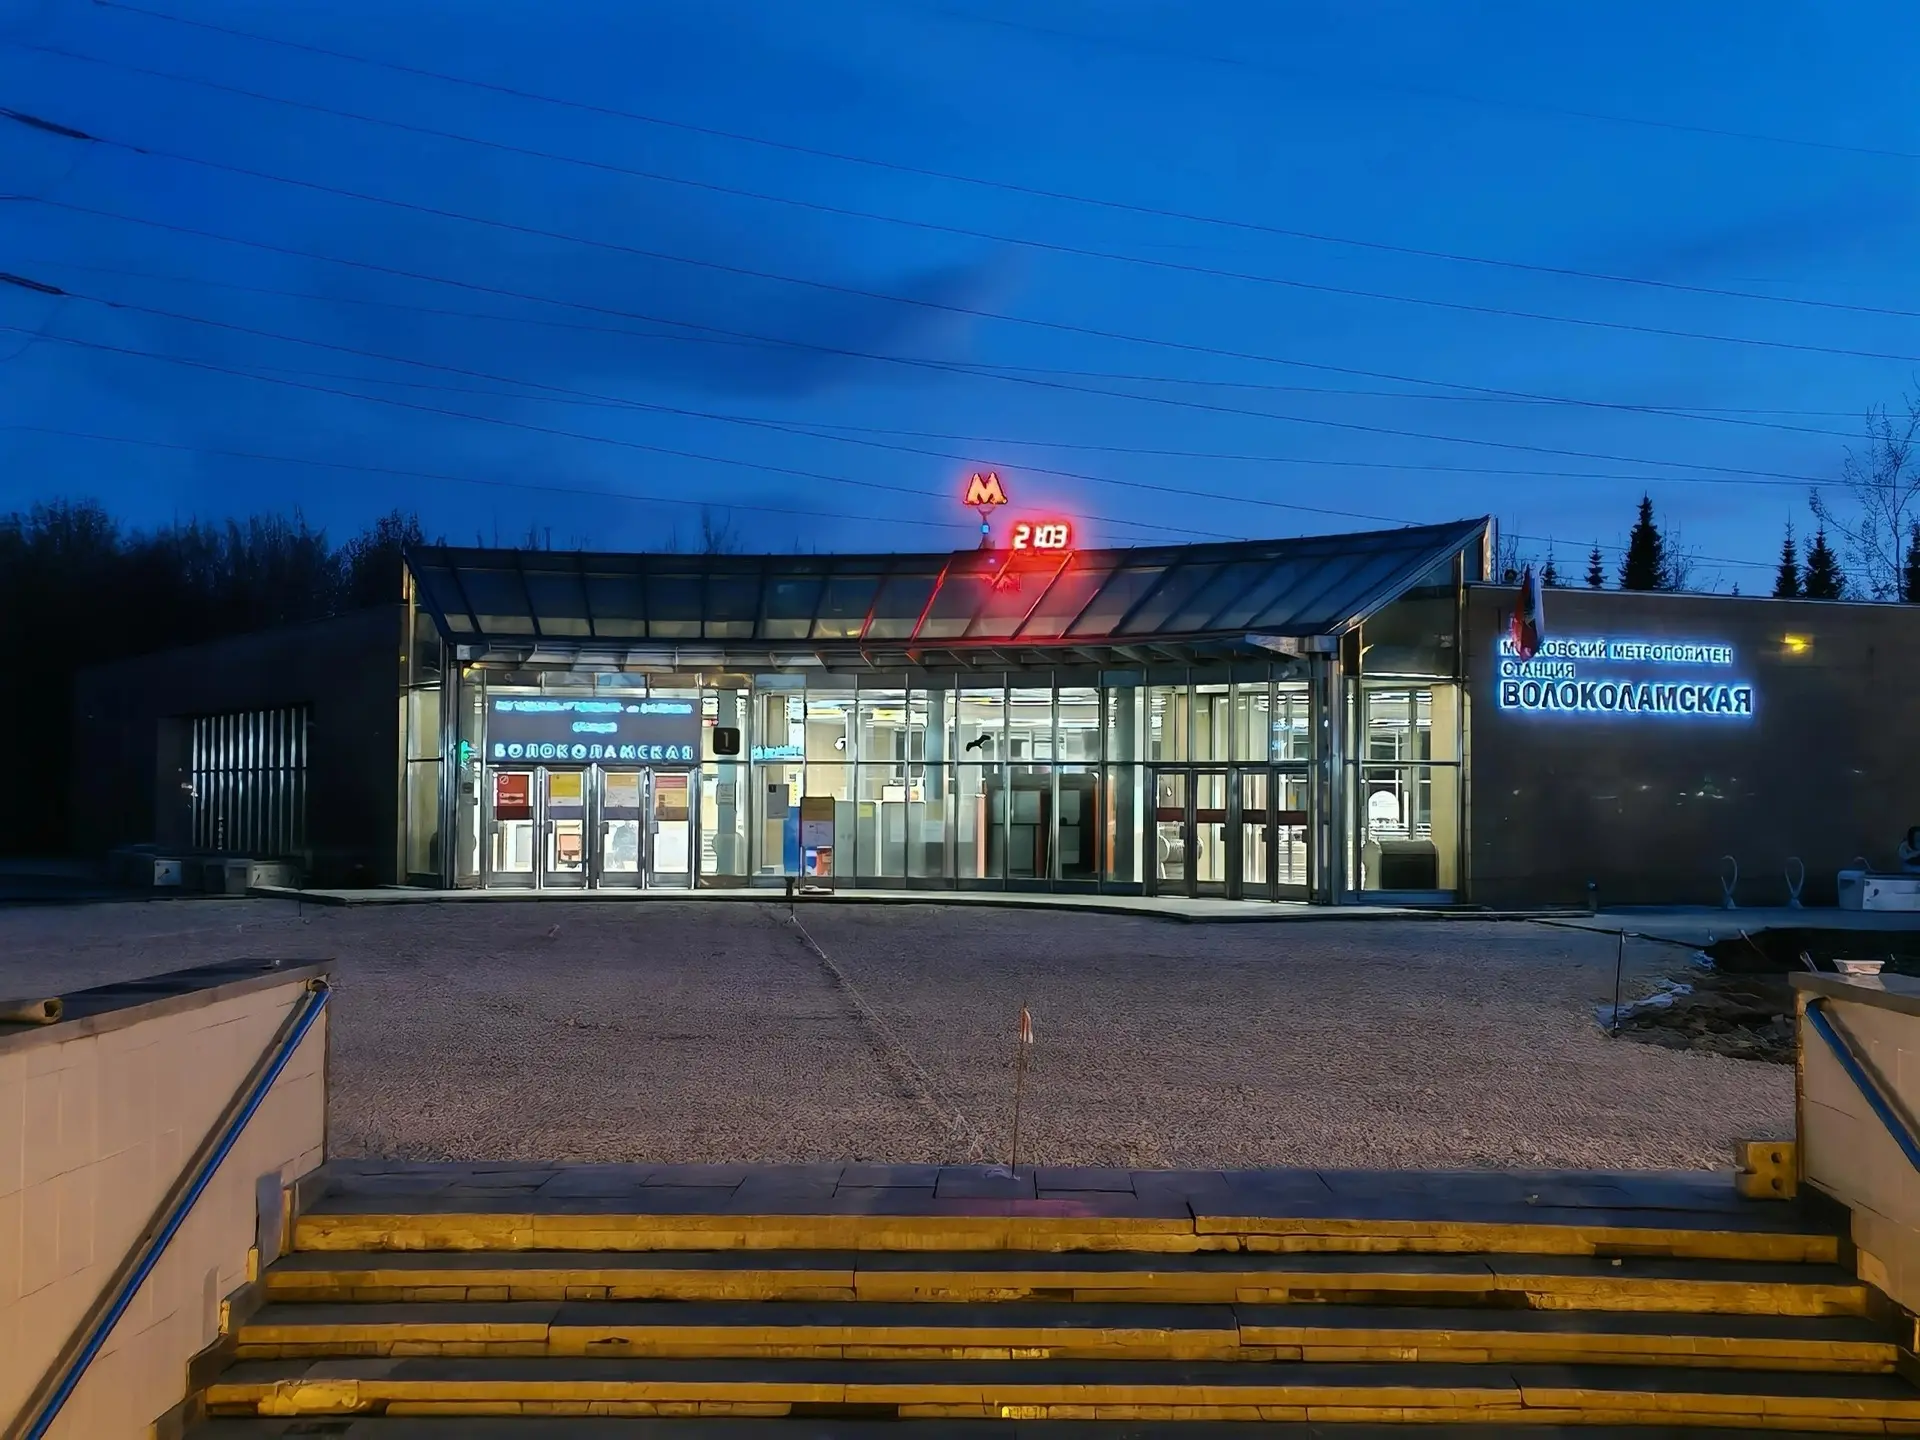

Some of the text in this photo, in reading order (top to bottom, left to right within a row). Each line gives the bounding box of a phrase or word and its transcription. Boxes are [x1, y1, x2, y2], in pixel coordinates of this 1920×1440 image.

[1613, 645, 1732, 662] МЕТРОПОЛИТЕН
[1503, 663, 1575, 679] СТАНЦИЯ
[1503, 682, 1751, 712] ВОЛОКОЛАМСКАЯ
[494, 743, 693, 760] ВОЛОКОЛАМСКАЯ
